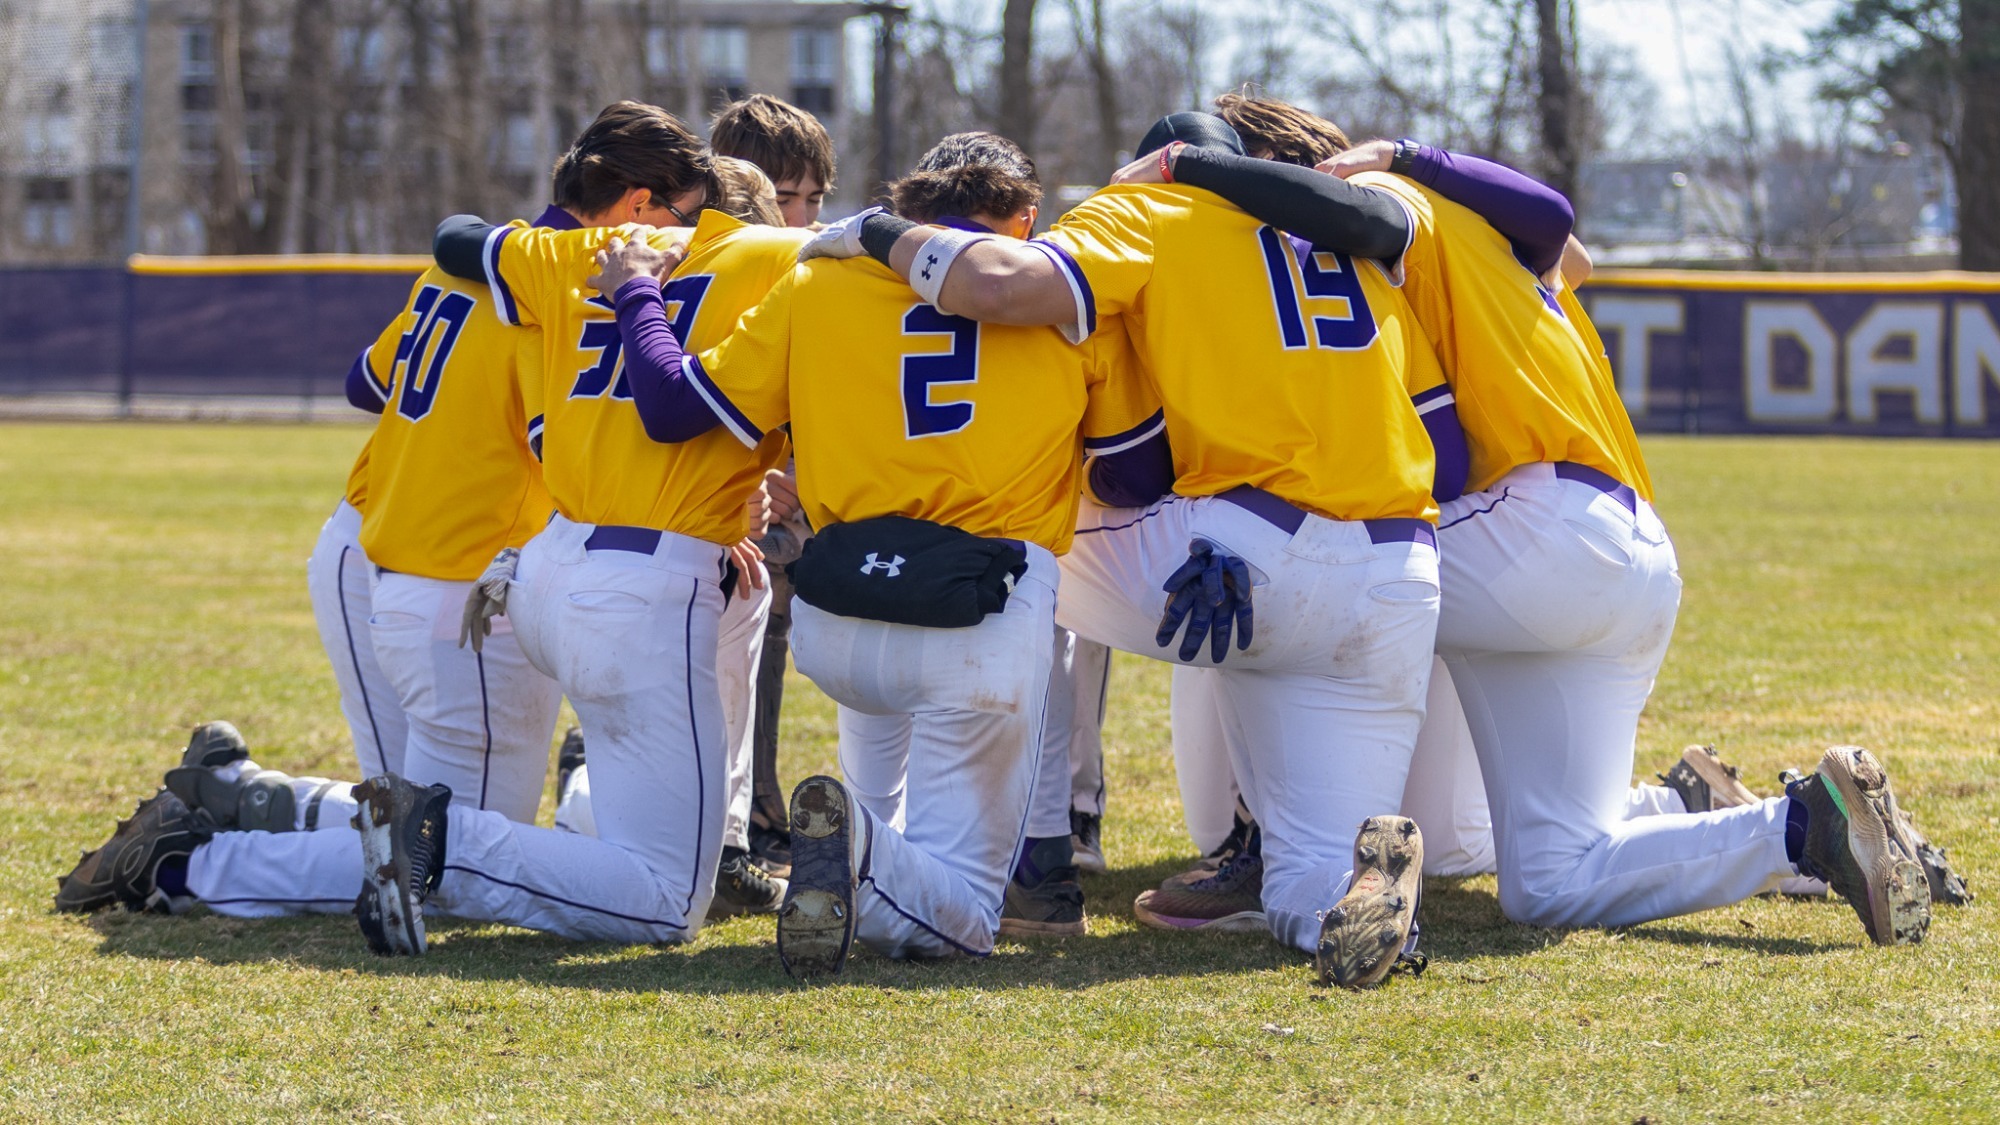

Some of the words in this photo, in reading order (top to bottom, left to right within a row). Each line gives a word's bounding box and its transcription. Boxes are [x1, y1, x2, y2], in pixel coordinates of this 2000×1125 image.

[386, 284, 477, 424] 20
[1256, 223, 1380, 350] 19
[901, 302, 981, 440] 2
